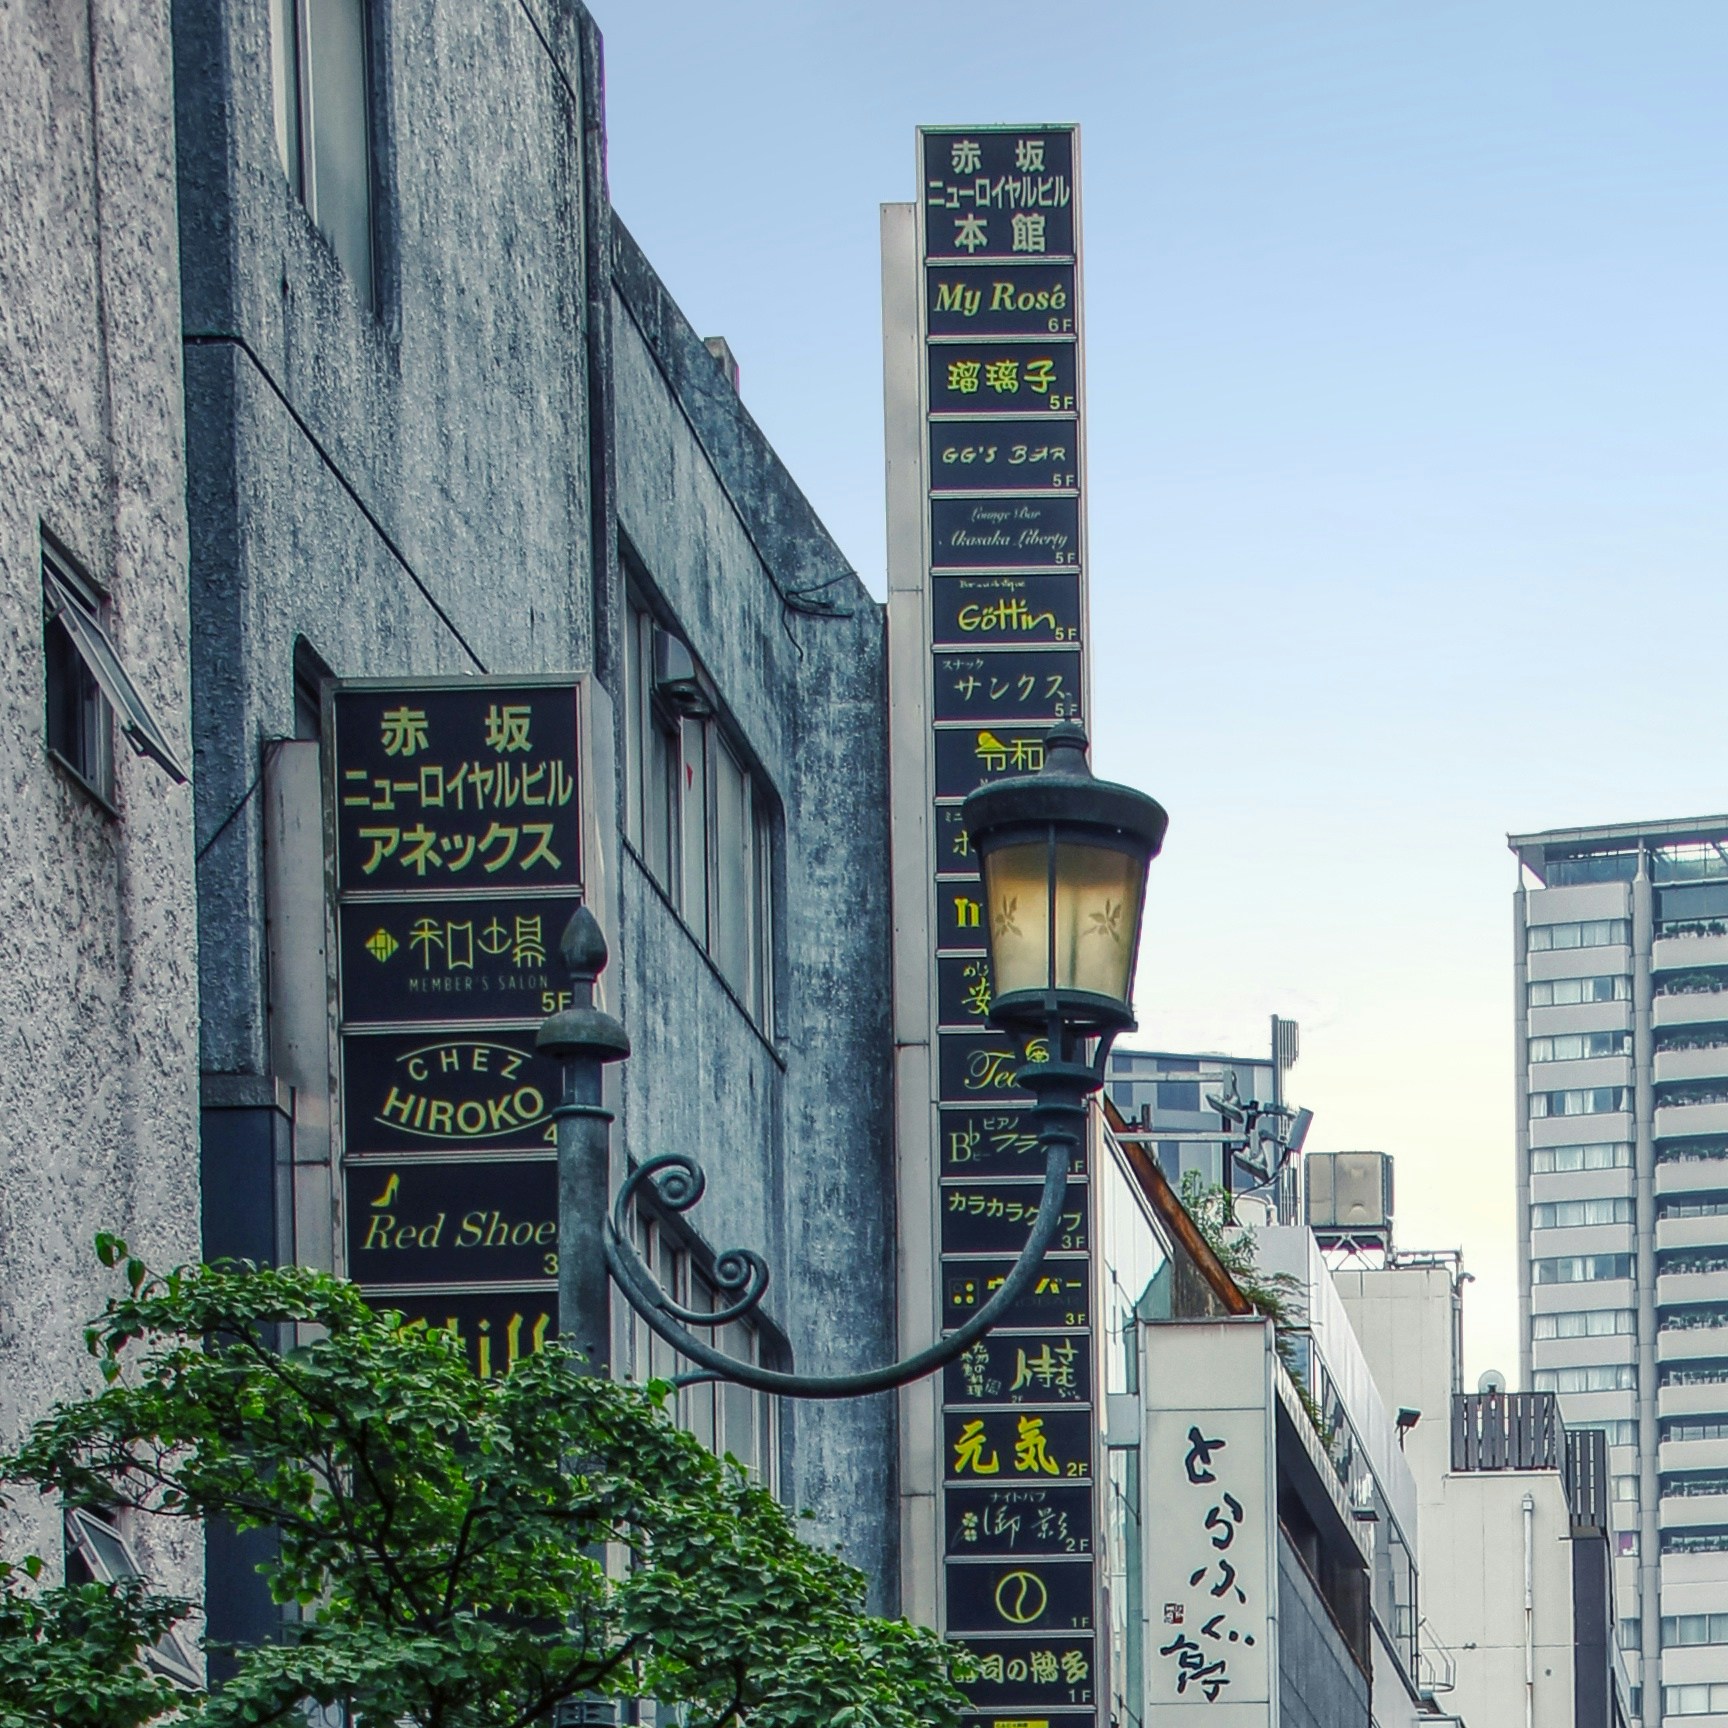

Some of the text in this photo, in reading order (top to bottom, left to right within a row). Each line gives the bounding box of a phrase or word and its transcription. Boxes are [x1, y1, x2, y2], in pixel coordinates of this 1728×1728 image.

[951, 140, 1045, 174] 赤坂
[928, 175, 1070, 210] ニューロイヤルビル
[954, 213, 1047, 254] 本館
[935, 281, 1067, 317] My Rosé
[1048, 316, 1072, 334] 6F
[948, 359, 1057, 396] 瑠璃子
[1049, 395, 1075, 412] 5F
[1052, 473, 1076, 489] 5F
[1055, 550, 1077, 566] 5F
[1055, 626, 1078, 642] 5F
[954, 674, 1070, 702] サンクス
[381, 705, 533, 757] 赤坂
[344, 759, 574, 812] ニューロイヤルビル
[360, 823, 562, 876] アネックス
[541, 989, 573, 1013] 5F
[408, 1046, 522, 1082] CHEZ
[382, 1086, 544, 1134] HIROKO
[360, 1212, 441, 1252] Red
[1061, 1235, 1086, 1250] 3F
[1065, 1311, 1087, 1325] 3F
[954, 1416, 1059, 1476] 元気
[1067, 1462, 1089, 1478] 2F
[1066, 1537, 1089, 1552] 2F
[1071, 1616, 1090, 1629] 1F
[1068, 1689, 1092, 1703] 1F
